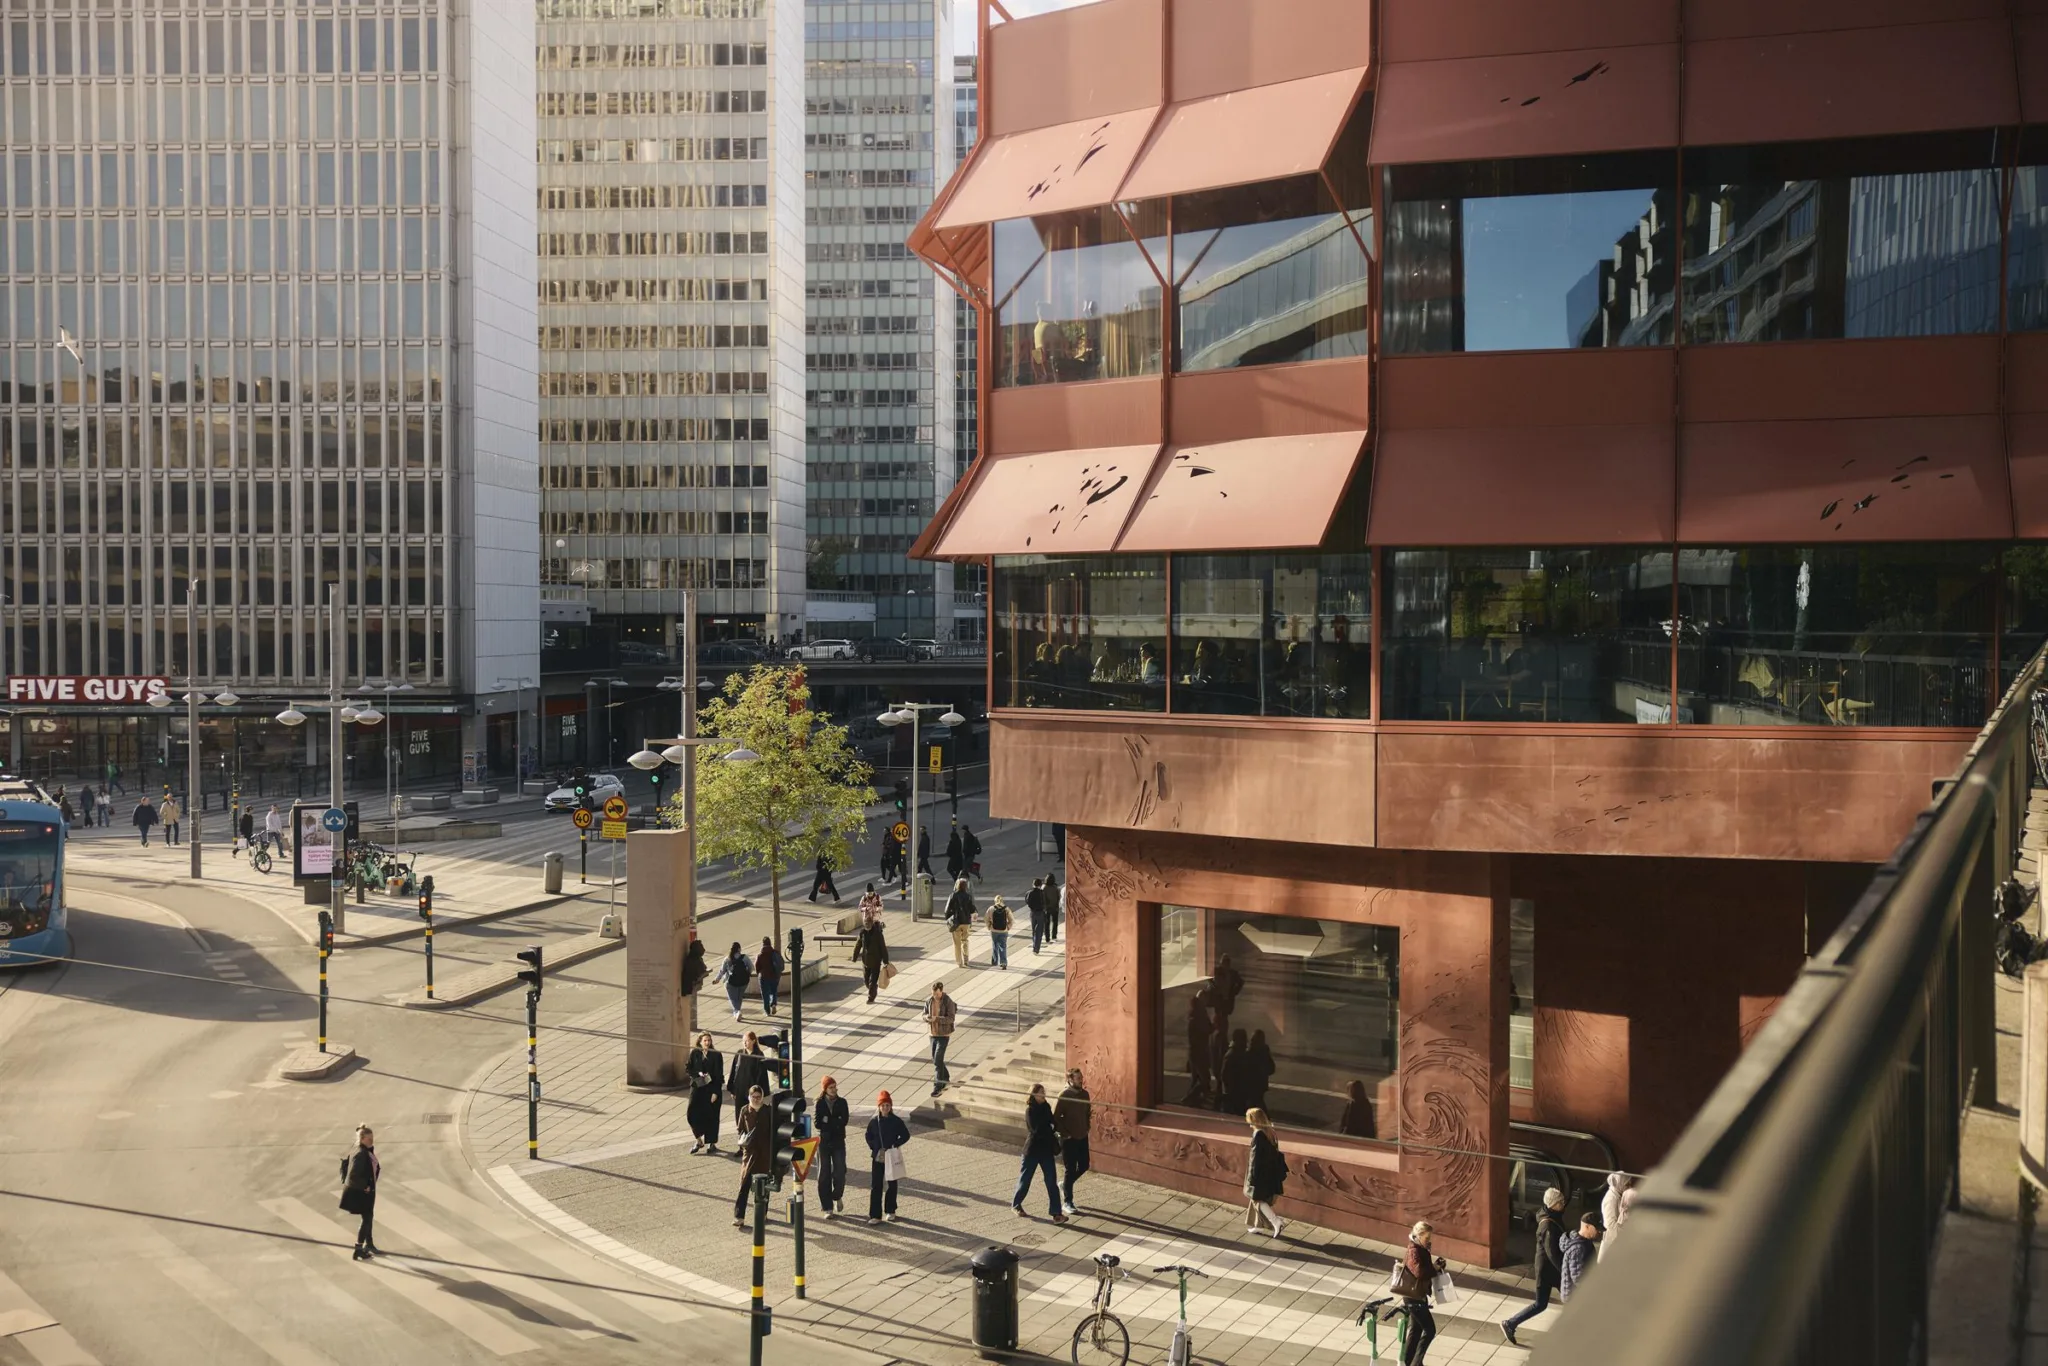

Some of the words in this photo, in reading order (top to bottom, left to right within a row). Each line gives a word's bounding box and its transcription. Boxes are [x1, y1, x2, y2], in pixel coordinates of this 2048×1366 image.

[10, 679, 76, 700] FIVE
[84, 679, 166, 700] GUYS
[562, 715, 575, 725] FIVE
[411, 730, 428, 742] FIVE
[409, 742, 431, 755] GUYS
[575, 813, 590, 823] 40
[895, 827, 909, 836] 40
